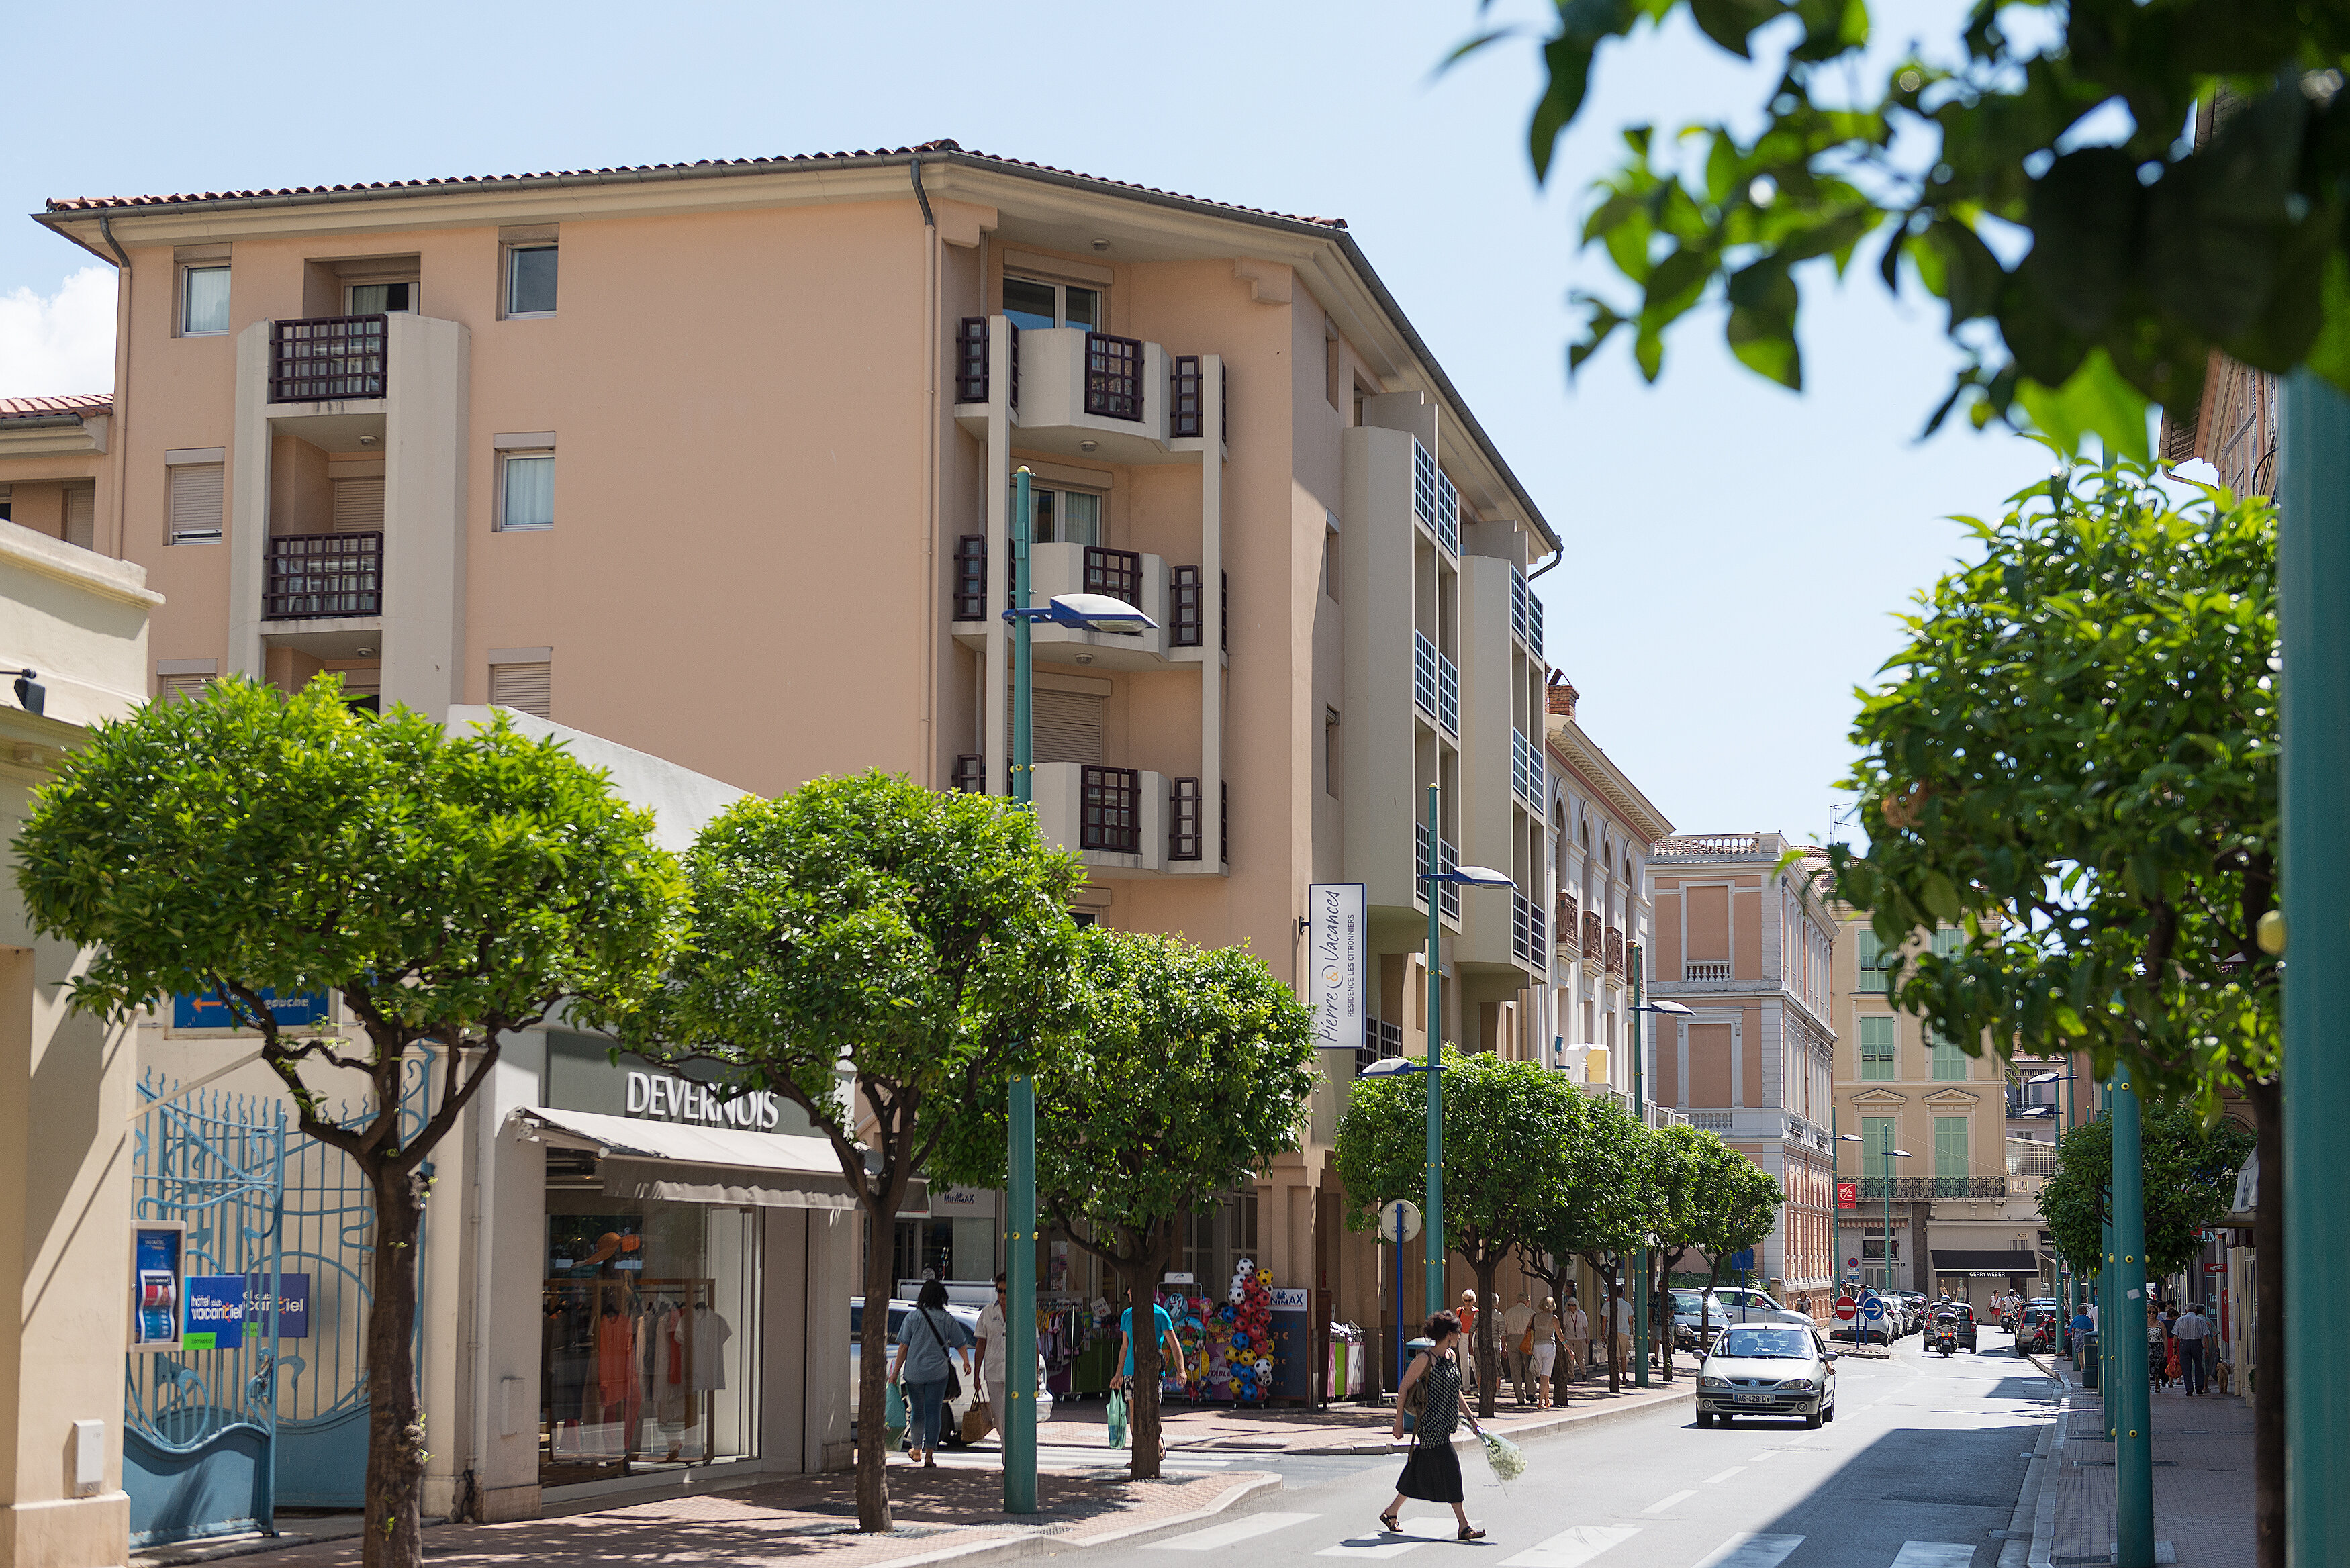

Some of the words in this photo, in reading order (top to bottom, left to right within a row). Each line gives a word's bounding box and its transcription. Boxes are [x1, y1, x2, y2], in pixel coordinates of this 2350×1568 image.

[1318, 890, 1340, 961] Vacances
[1347, 914, 1355, 961] CITRONNIERS
[1318, 993, 1339, 1042] Pierre
[626, 1071, 779, 1128] DEVERNOIS
